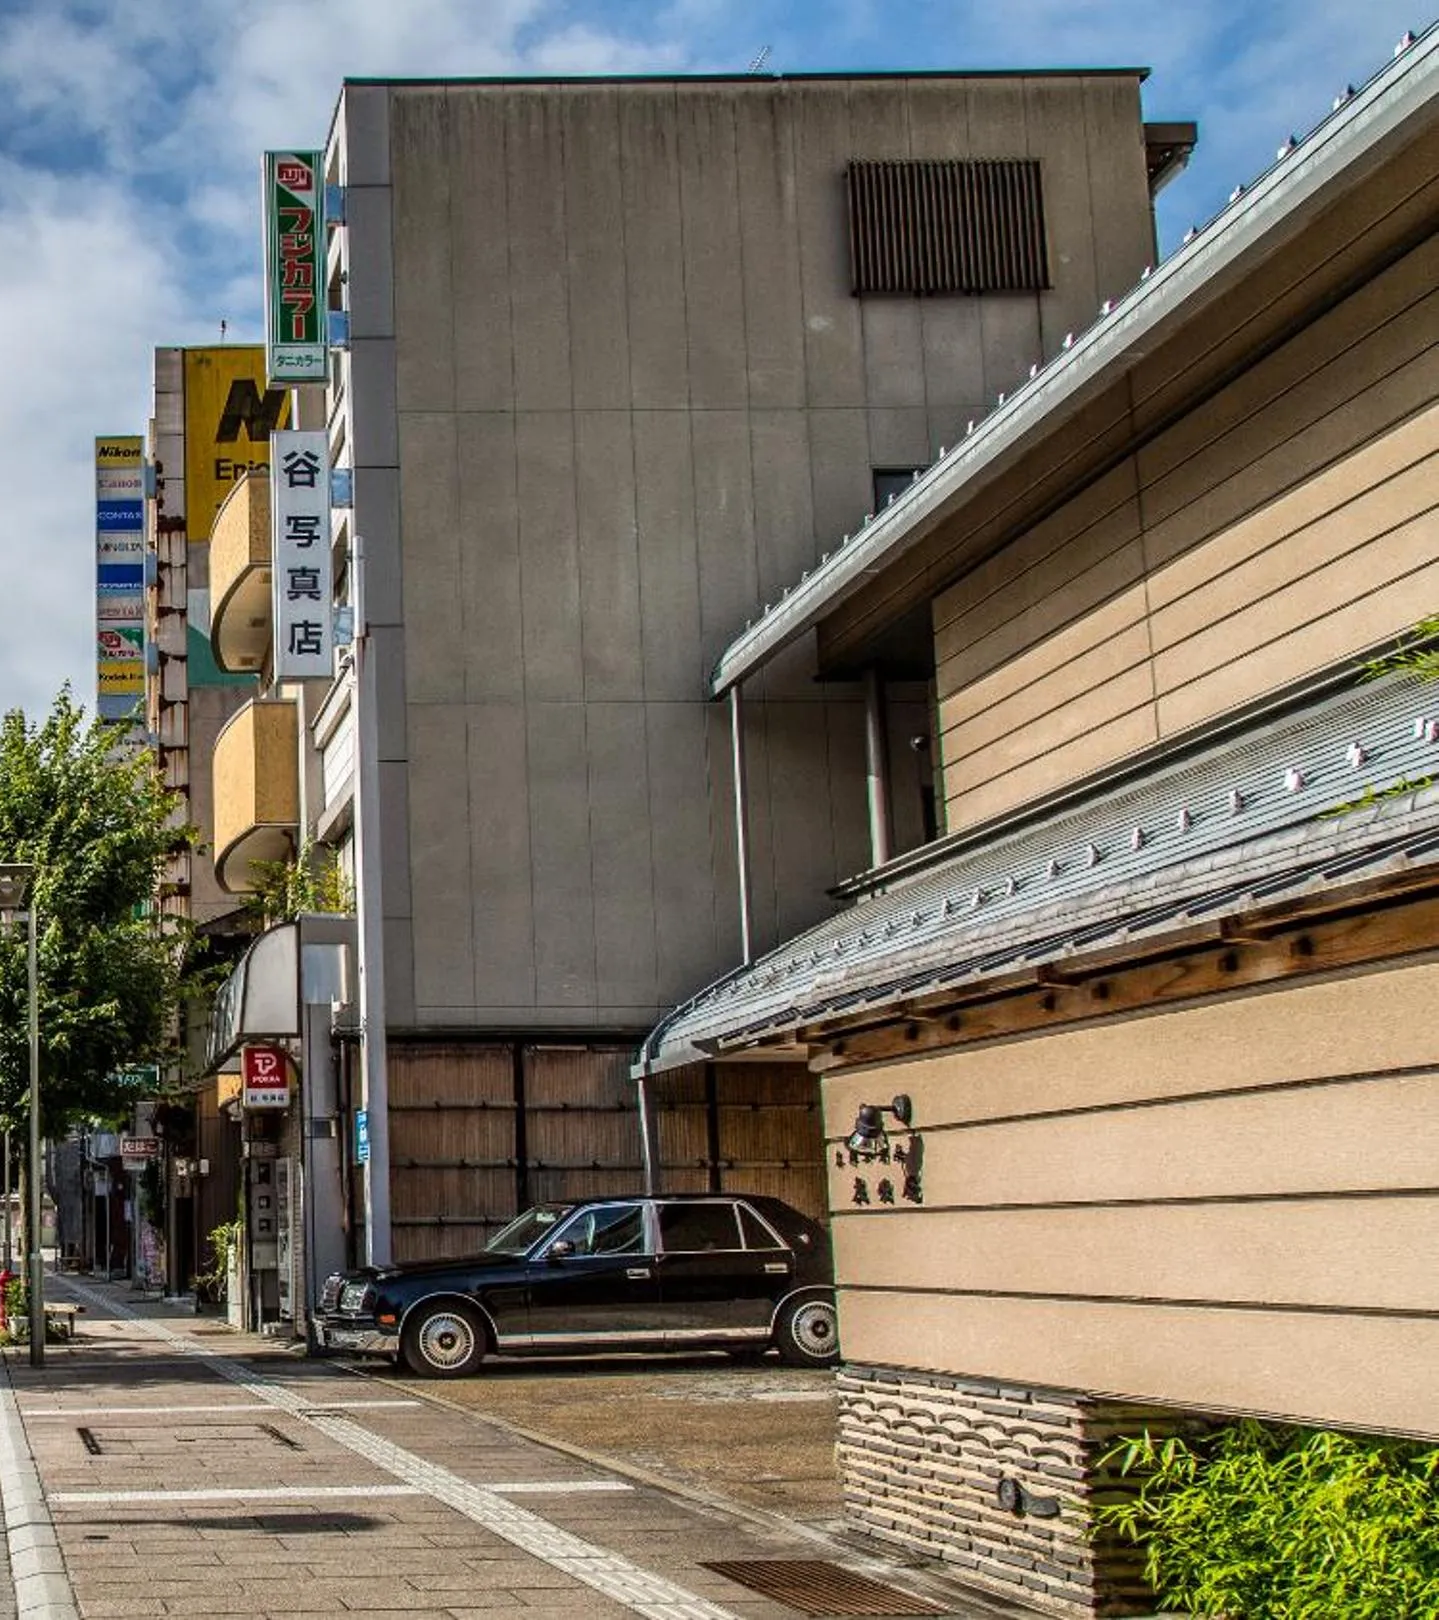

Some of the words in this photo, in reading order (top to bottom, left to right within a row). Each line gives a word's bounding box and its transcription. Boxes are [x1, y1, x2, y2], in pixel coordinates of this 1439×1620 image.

[280, 207, 314, 341] フジカラー
[275, 353, 323, 367] タニカラー
[99, 446, 141, 457] Nikon
[98, 511, 143, 521] CONTAX
[282, 450, 323, 656] 谷写真店
[123, 1141, 157, 1153] たばこ
